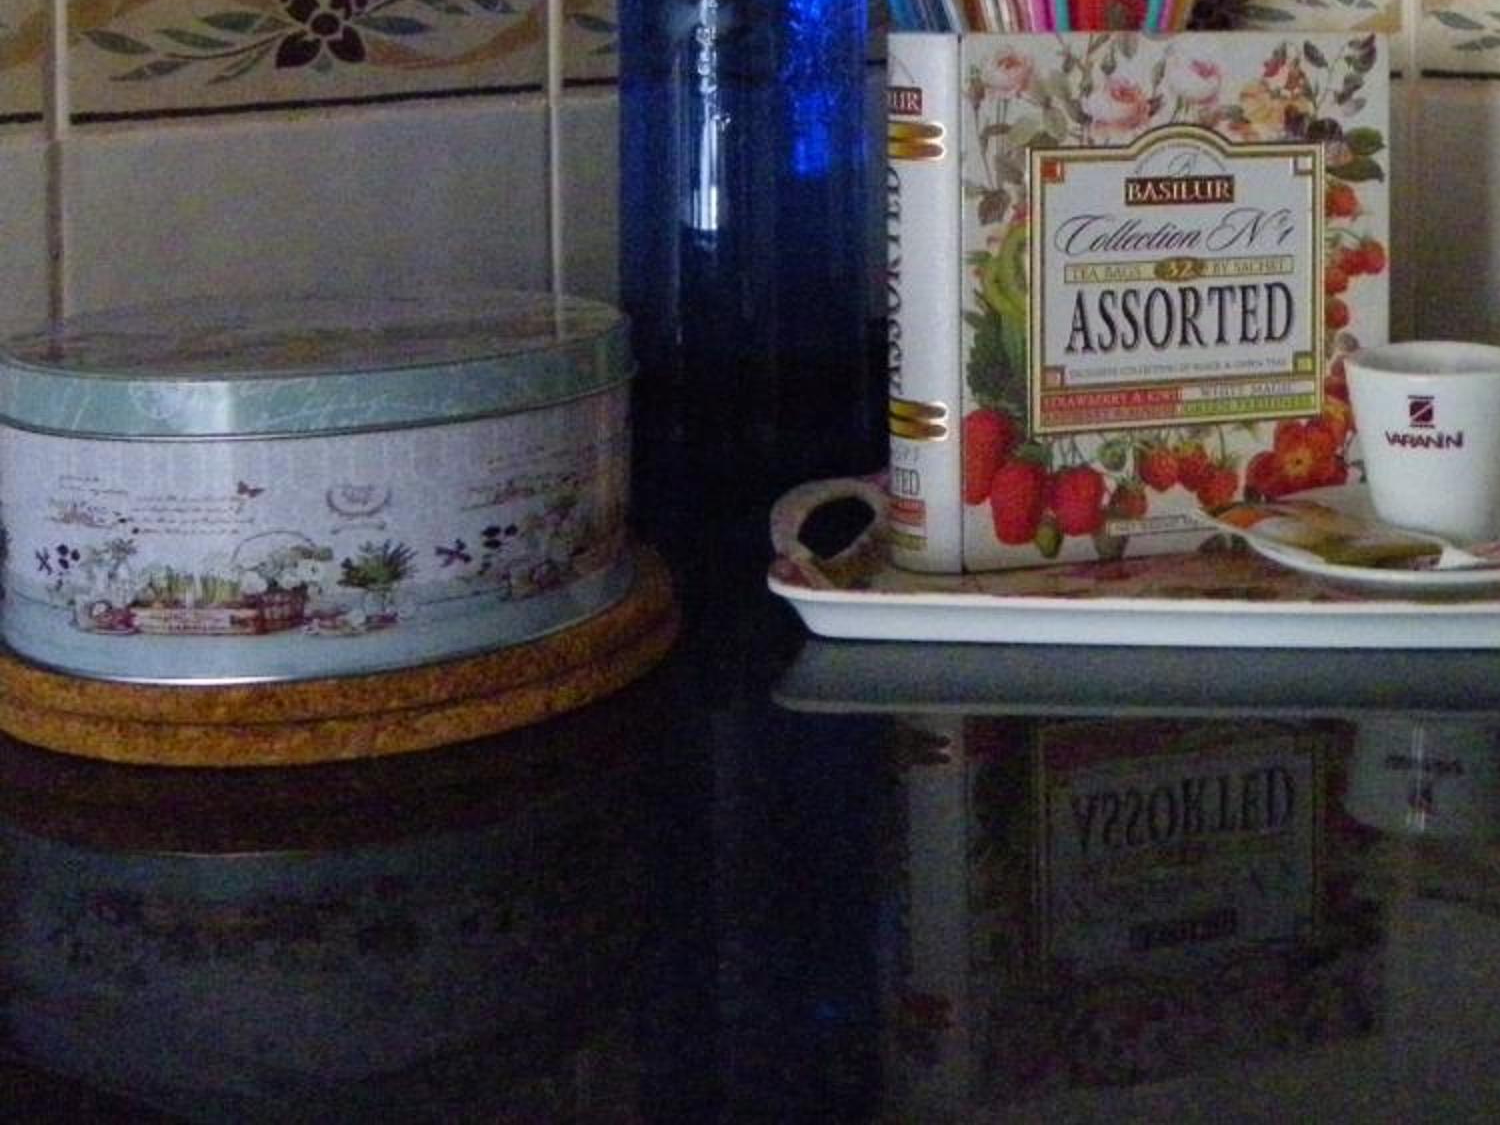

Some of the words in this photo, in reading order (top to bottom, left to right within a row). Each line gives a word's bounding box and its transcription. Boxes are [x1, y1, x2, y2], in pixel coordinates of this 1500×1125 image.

[1126, 178, 1232, 202] BASILUR
[1054, 214, 1201, 257] Collection
[1065, 282, 1295, 355] ASSORTED
